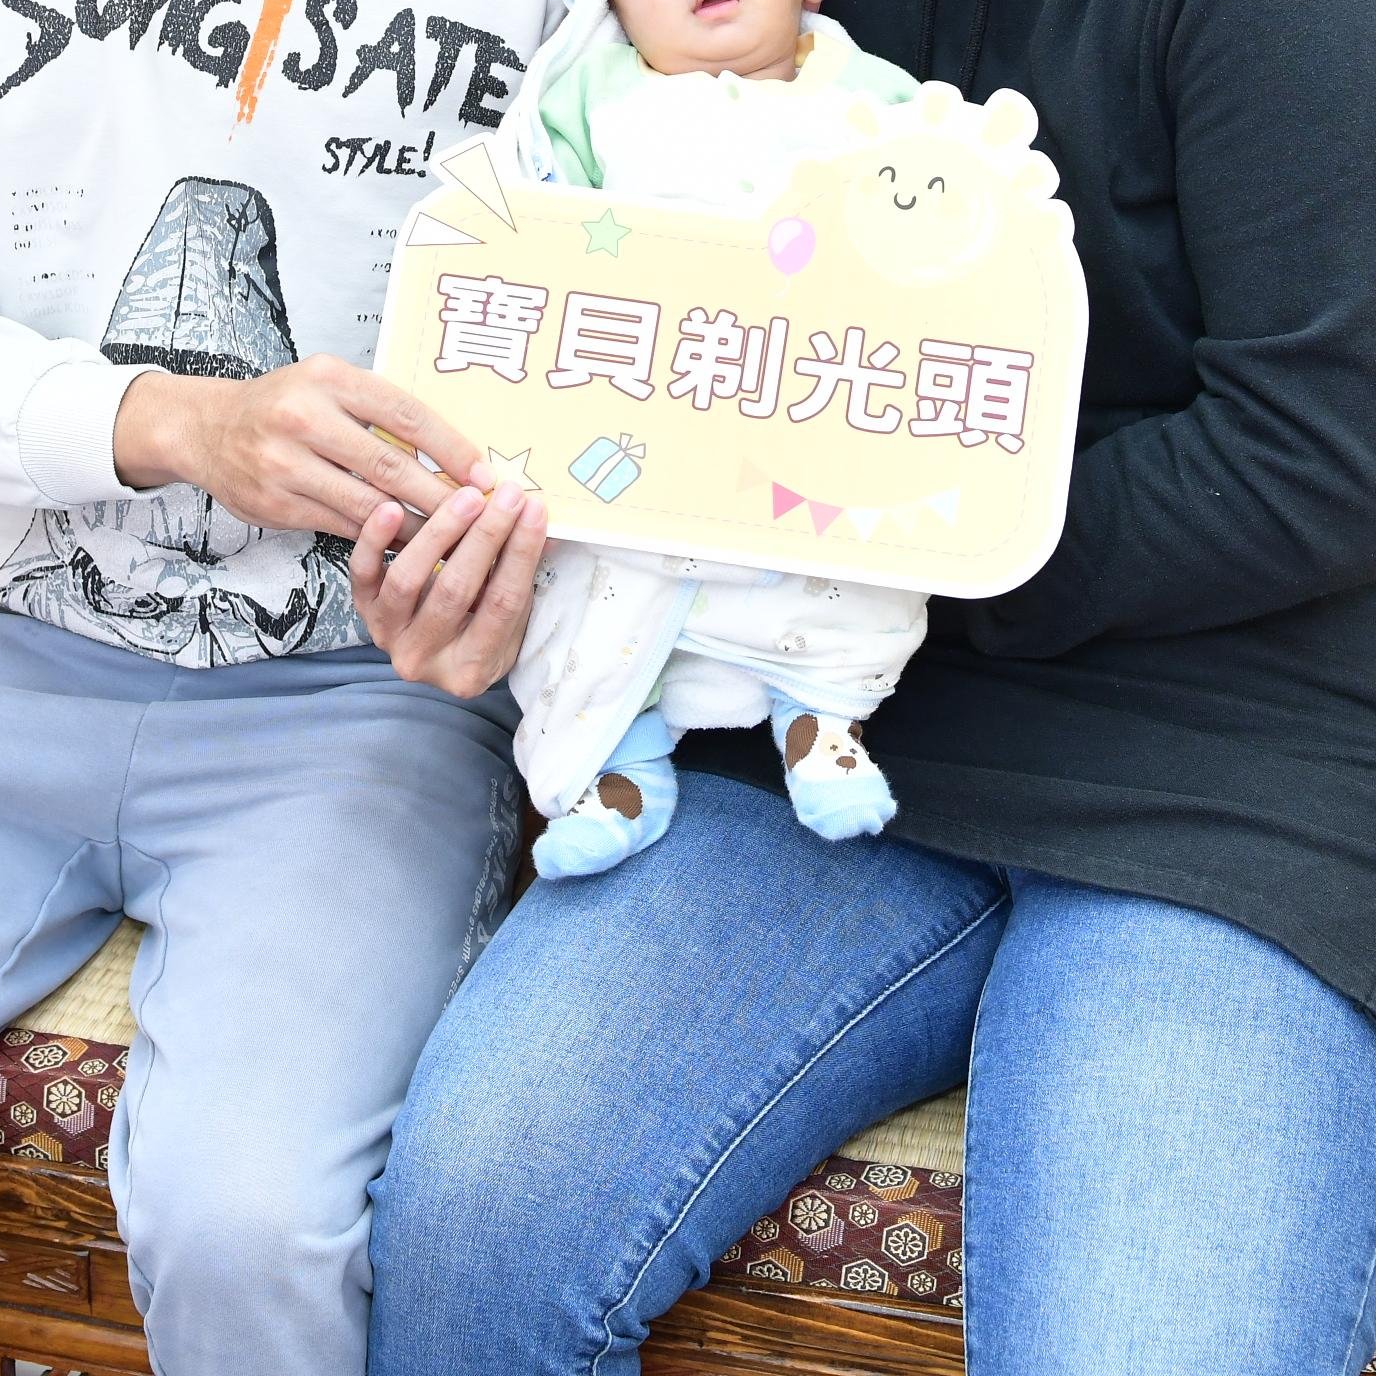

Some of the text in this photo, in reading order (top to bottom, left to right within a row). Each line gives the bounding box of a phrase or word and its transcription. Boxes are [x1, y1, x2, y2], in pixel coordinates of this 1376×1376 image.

[322, 131, 435, 177] STYLE!
[434, 273, 1035, 454] 寶貝剃光頭
[461, 932, 472, 964] FAITH
